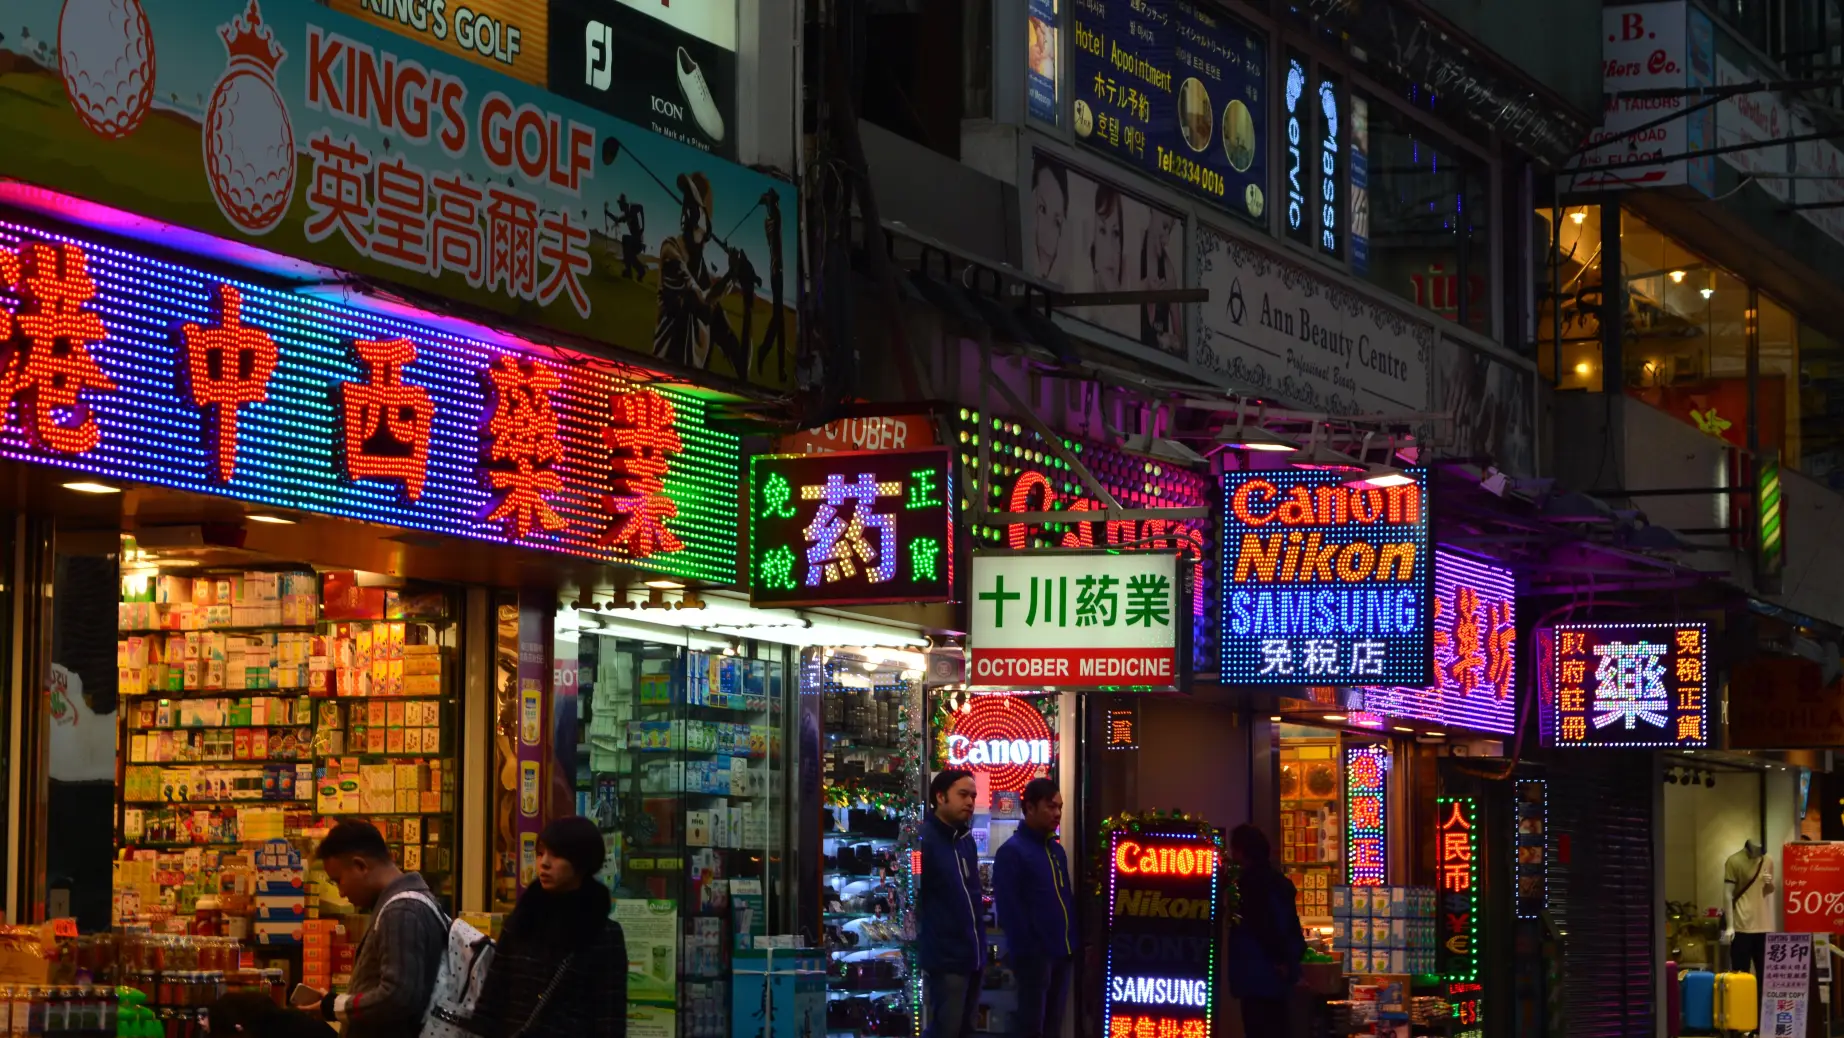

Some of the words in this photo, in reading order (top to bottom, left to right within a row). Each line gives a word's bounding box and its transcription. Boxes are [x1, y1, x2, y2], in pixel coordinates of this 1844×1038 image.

[455, 7, 520, 64] GOLF
[1075, 20, 1104, 58] Hotel
[1110, 39, 1172, 94] Appointment
[310, 31, 467, 153] KING'S
[482, 98, 593, 192] GOLF
[651, 94, 684, 122] ICON
[1094, 71, 1149, 124] ホテル予約
[1097, 111, 1120, 148] 호텔
[1123, 125, 1146, 160] 예약
[1202, 167, 1225, 197] 0016
[308, 136, 591, 314] 英皇高爾夫
[1260, 291, 1294, 337] Ann
[1299, 307, 1354, 371] Beauty
[1358, 334, 1408, 382] Centre
[905, 469, 943, 582] 正貨
[1232, 478, 1420, 527] Canon
[1233, 530, 1418, 583] Nikon
[1230, 588, 1418, 636] SAMSUNG
[977, 657, 1070, 677] OCTOBER
[1079, 657, 1171, 677] MEDICINE
[1560, 632, 1587, 741] 政府註冊
[1592, 640, 1669, 730] 藥
[947, 733, 1051, 765] Canon
[1115, 841, 1214, 876] Canon
[1114, 888, 1210, 921] Nikon
[1787, 890, 1844, 916] 50%
[1767, 943, 1809, 962] 影印
[1111, 976, 1207, 1007] SAMSUNG
[1767, 991, 1787, 999] COLOR
[1788, 991, 1806, 999] COPY
